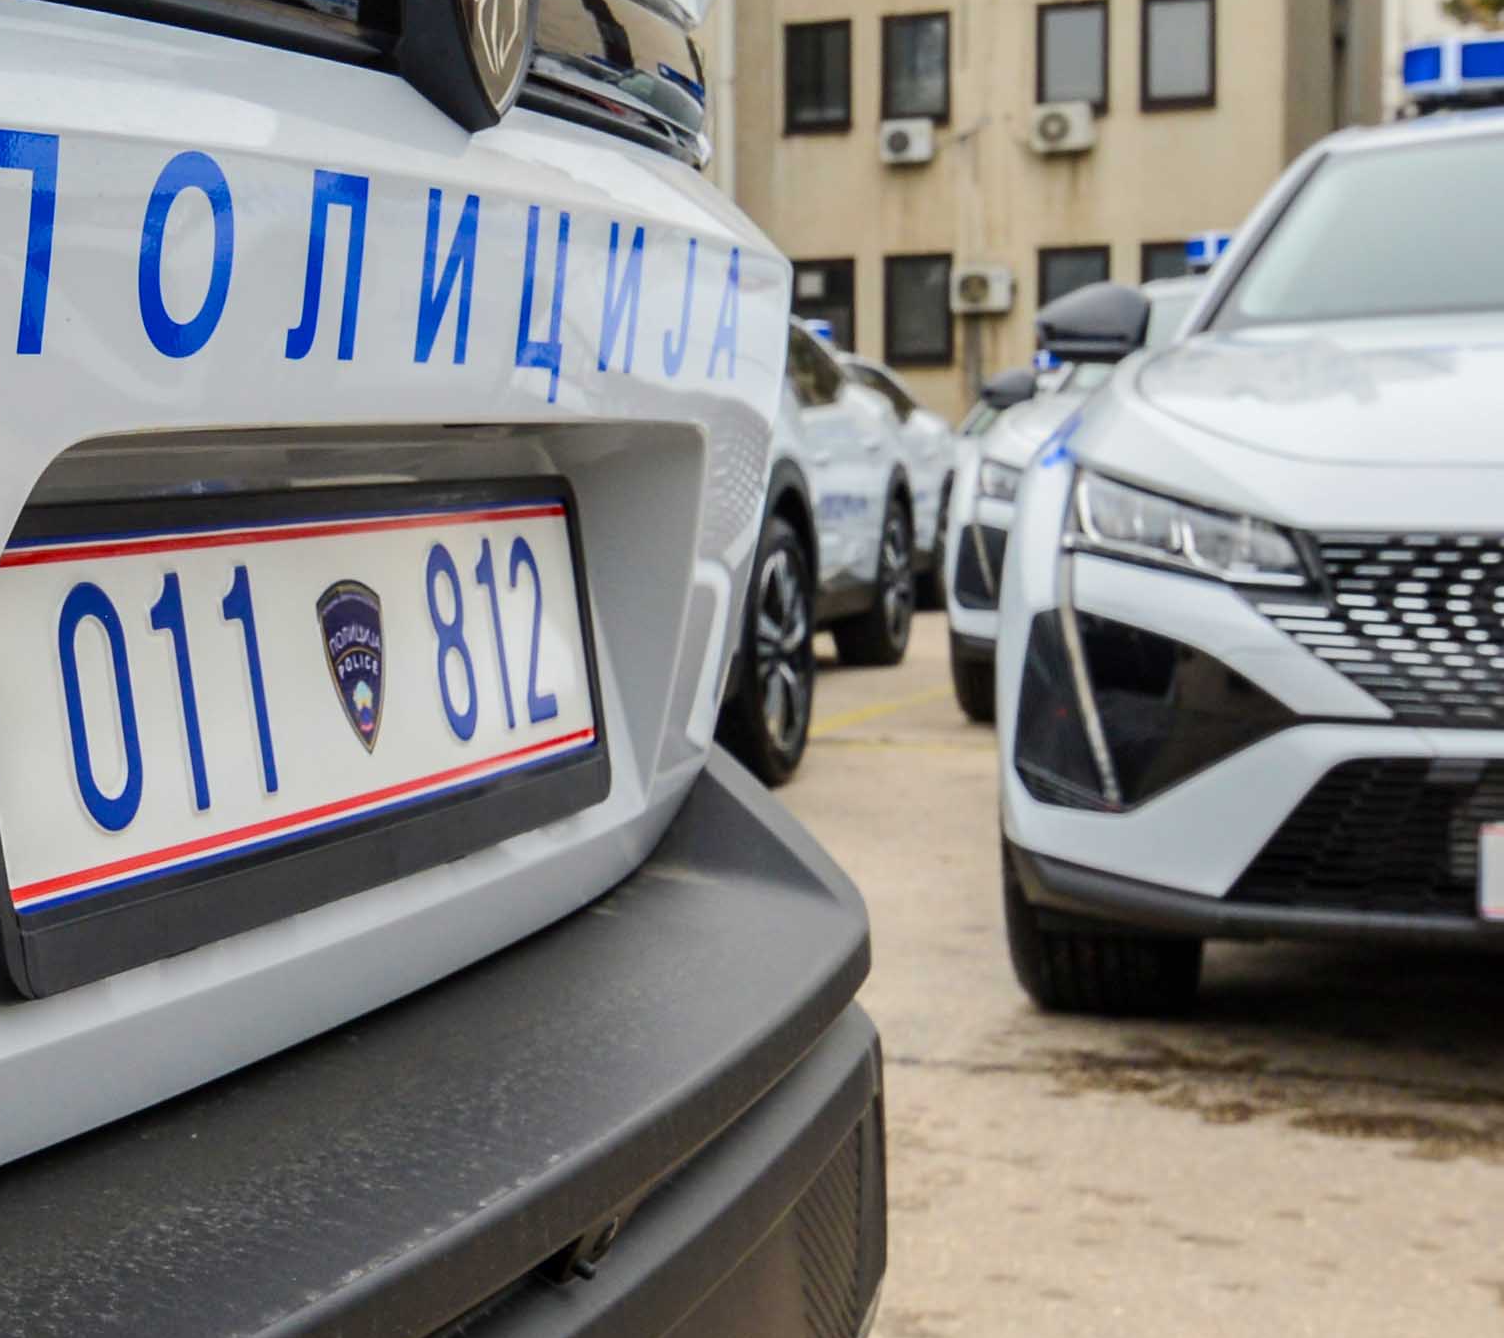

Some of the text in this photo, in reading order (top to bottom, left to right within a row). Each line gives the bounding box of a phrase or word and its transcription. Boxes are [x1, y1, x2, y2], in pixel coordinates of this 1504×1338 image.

[58, 537, 558, 832] 011 812
[338, 654, 379, 679] POLICE
